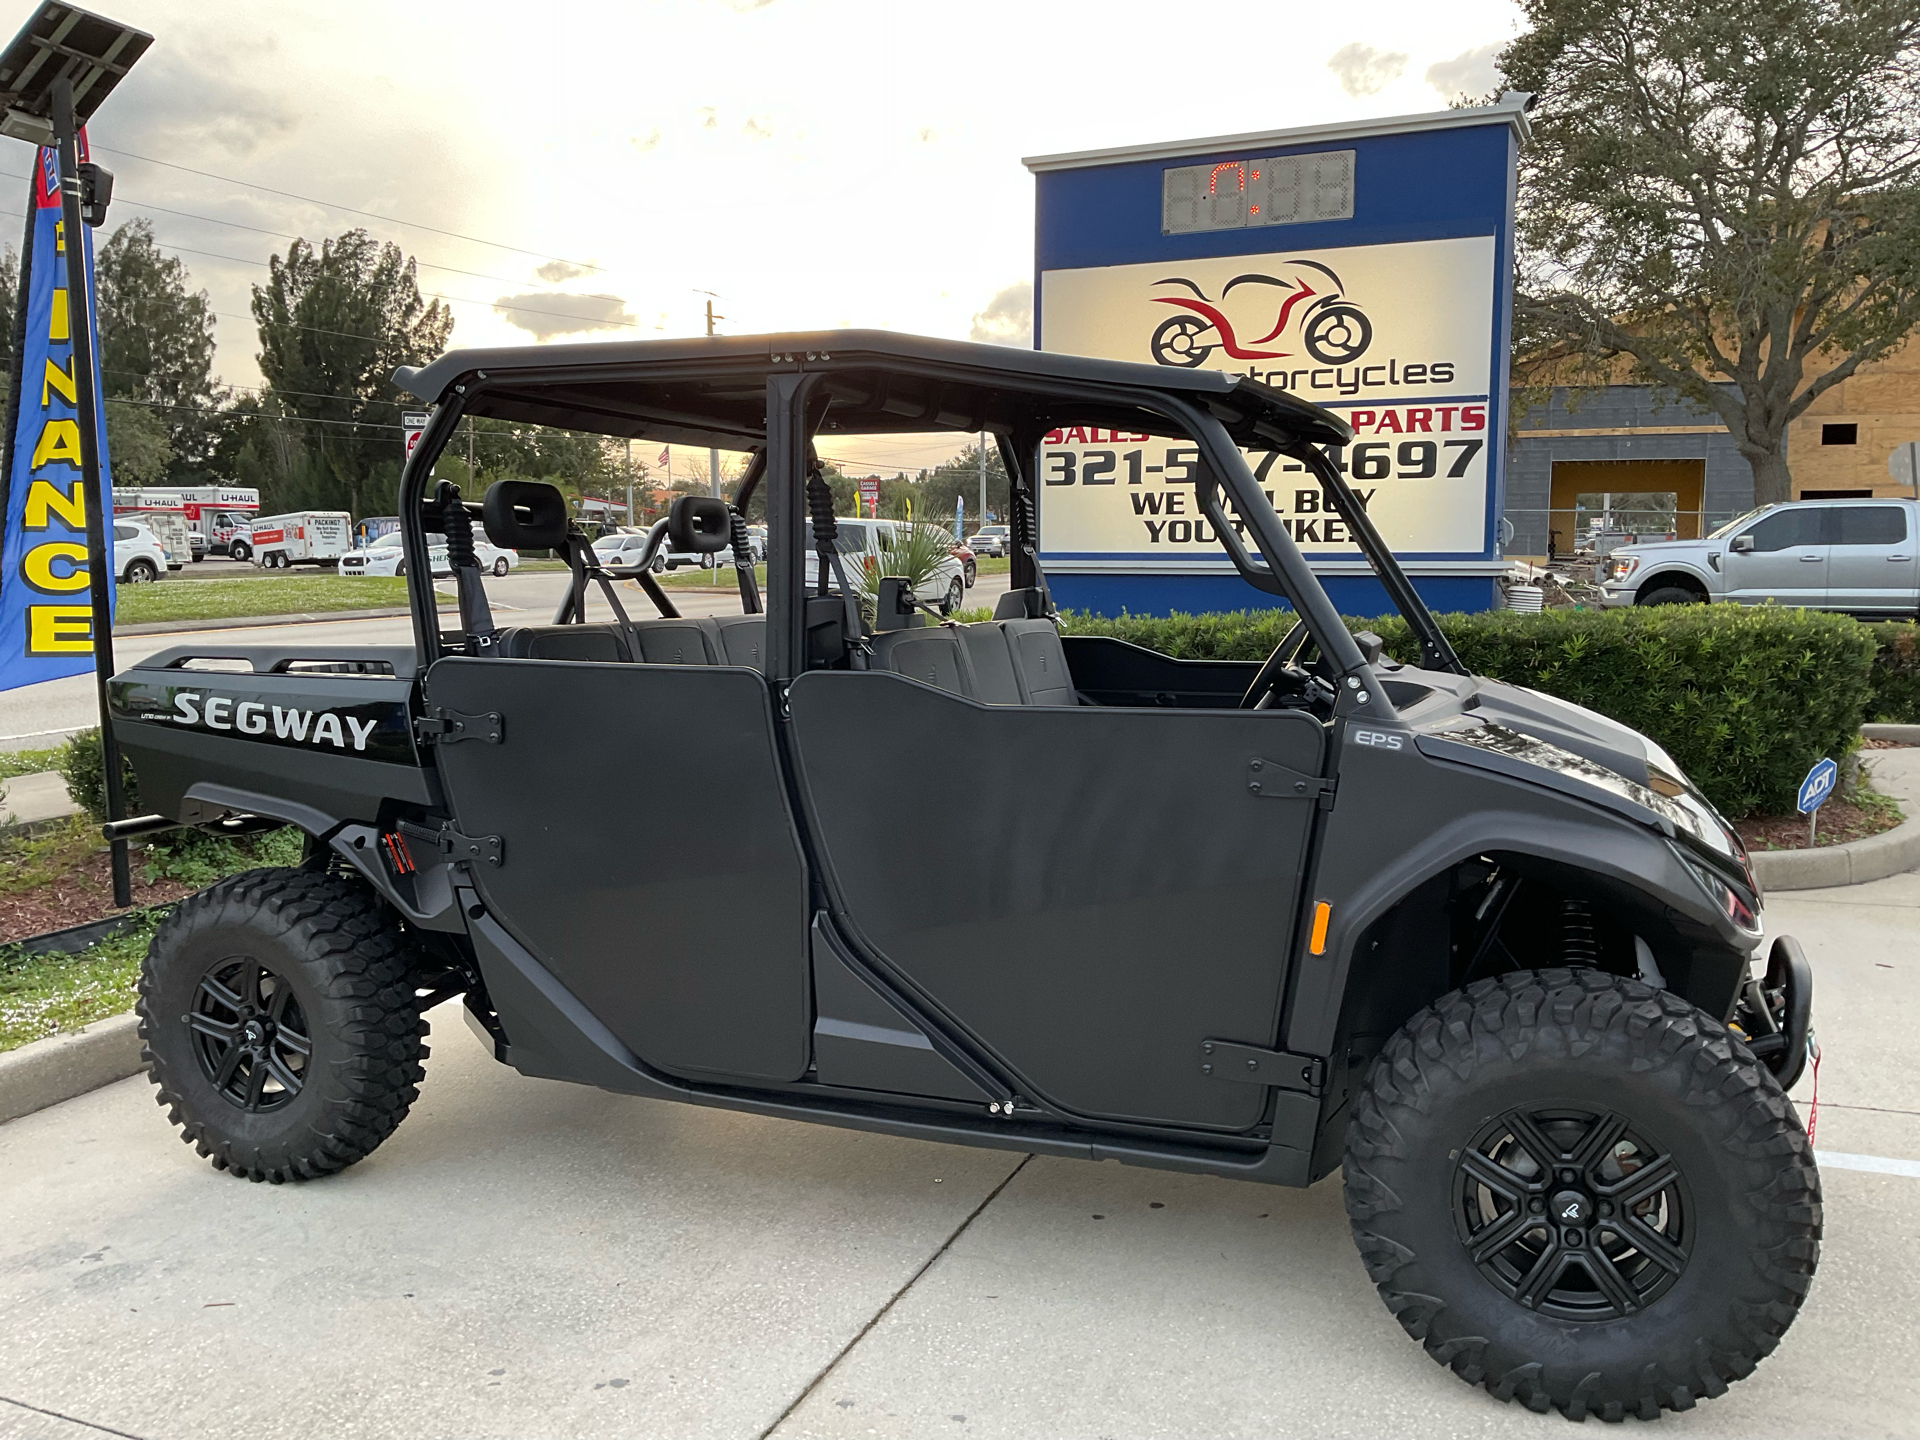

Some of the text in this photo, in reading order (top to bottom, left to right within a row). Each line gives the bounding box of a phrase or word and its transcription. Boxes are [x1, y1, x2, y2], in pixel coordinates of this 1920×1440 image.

[1350, 406, 1486, 434] PARTS
[1045, 439, 1483, 487] 321-57-4697
[1130, 492, 1185, 514] WE
[173, 693, 377, 750] SEGWAY
[1355, 730, 1403, 751] EPS
[1802, 766, 1834, 805] ADT
